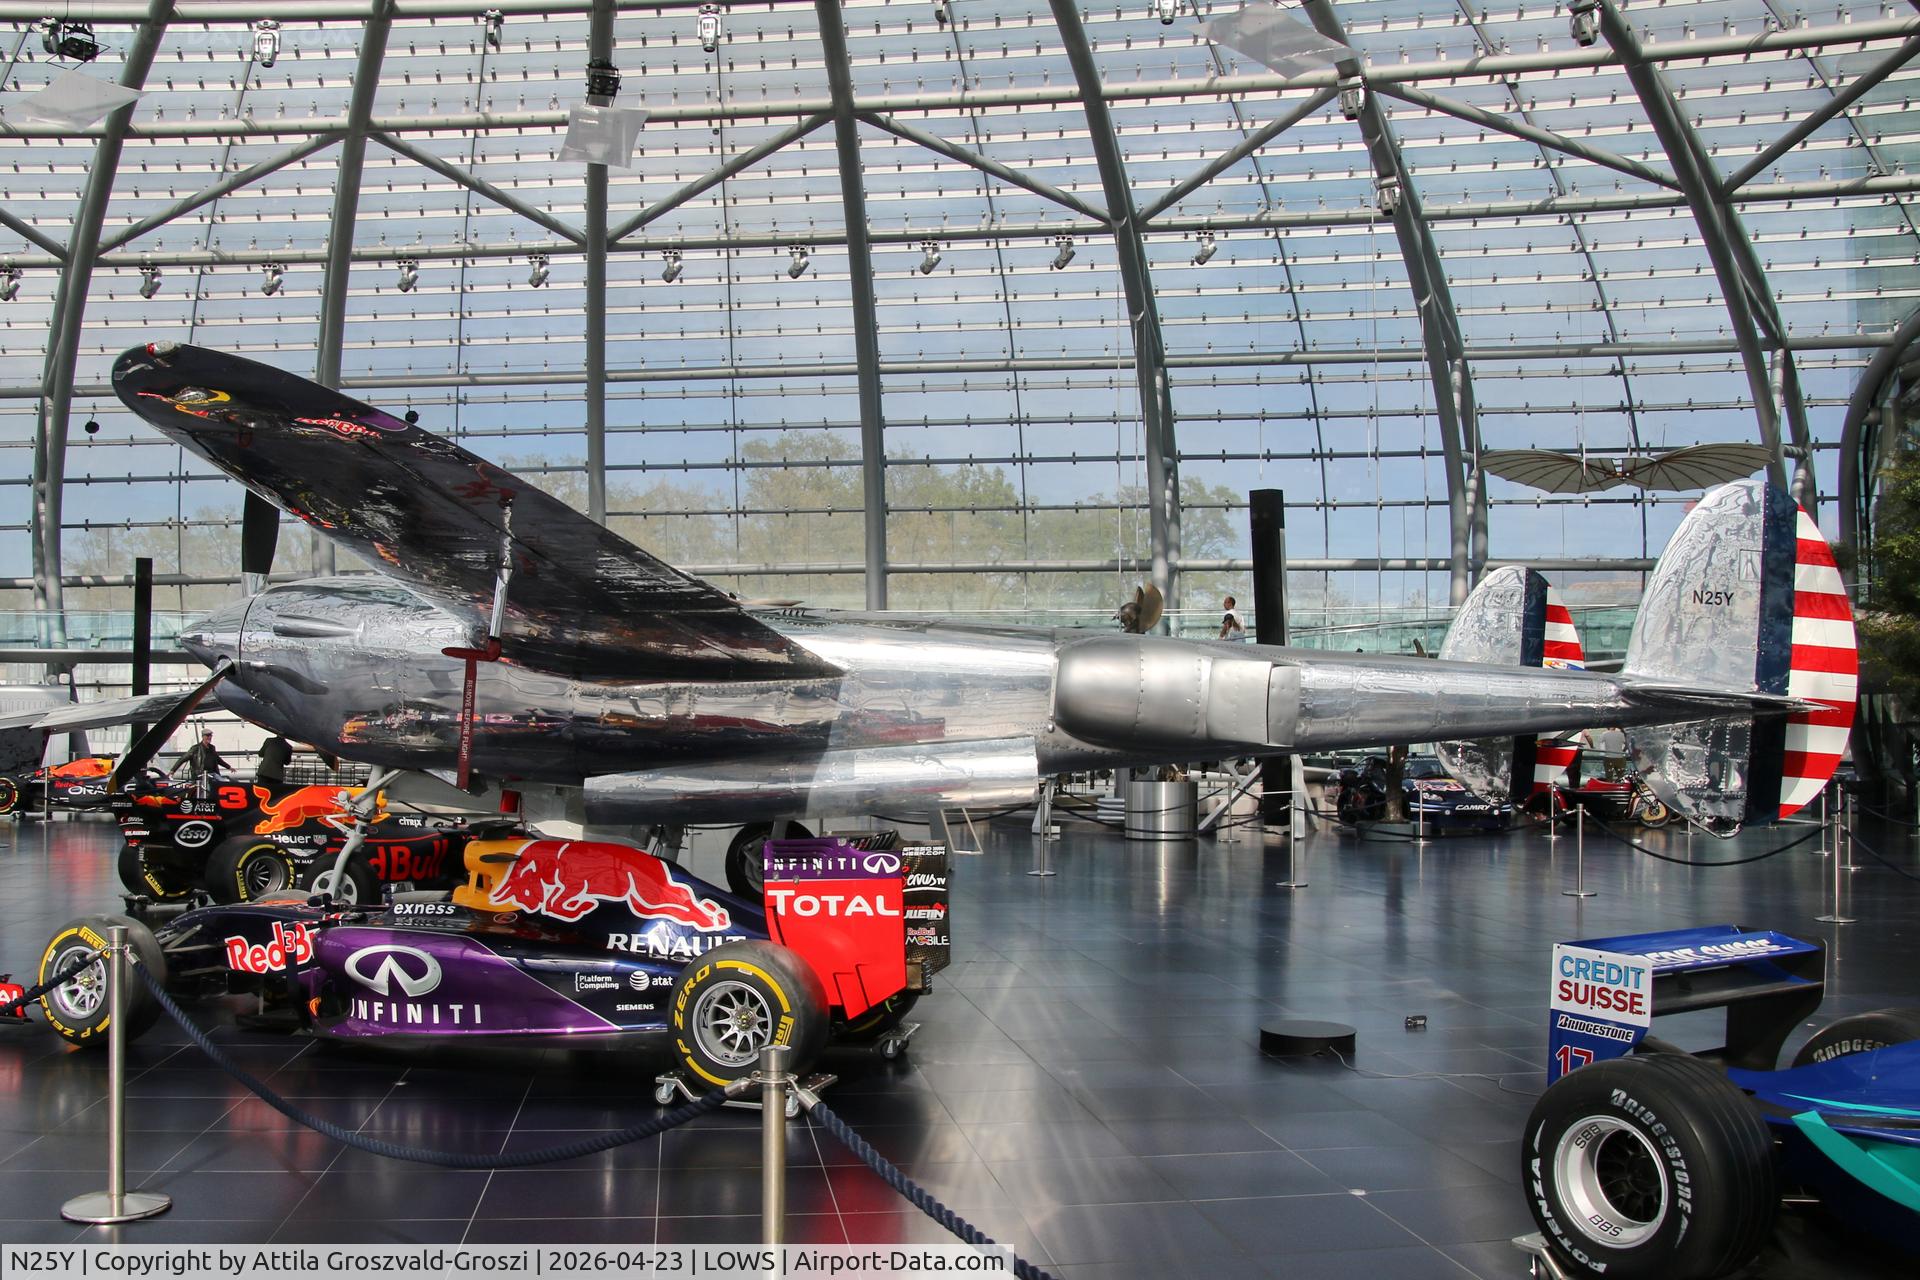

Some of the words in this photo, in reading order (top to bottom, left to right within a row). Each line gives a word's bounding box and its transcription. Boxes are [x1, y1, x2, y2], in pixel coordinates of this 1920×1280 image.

[1693, 589, 1734, 607] N25Y
[465, 679, 473, 708] REMOVE
[462, 708, 472, 735] BEFORE
[460, 735, 470, 761] FLIGHT
[194, 803, 216, 813] AT&T
[218, 786, 248, 809] 3
[265, 833, 312, 845] Heuer
[764, 857, 857, 871] INFINITI
[394, 902, 456, 916] exness
[767, 889, 900, 917] TOTAL
[606, 933, 747, 958] RENAU
[652, 976, 674, 986] at&t
[1559, 955, 1645, 989] CREDIT
[579, 981, 620, 991] Computing
[674, 964, 711, 1031] ZERO
[1558, 980, 1645, 1016] SUISSE
[351, 998, 482, 1024] INFINITI
[616, 1003, 655, 1011] SIEMENS
[1558, 1015, 1634, 1042] BRIDGESTONE
[1574, 1124, 1602, 1150] BBS
[1610, 1088, 1692, 1215] BRIDGESTONE
[1531, 1157, 1608, 1274] POTENZA
[1588, 1214, 1623, 1237] BBS
